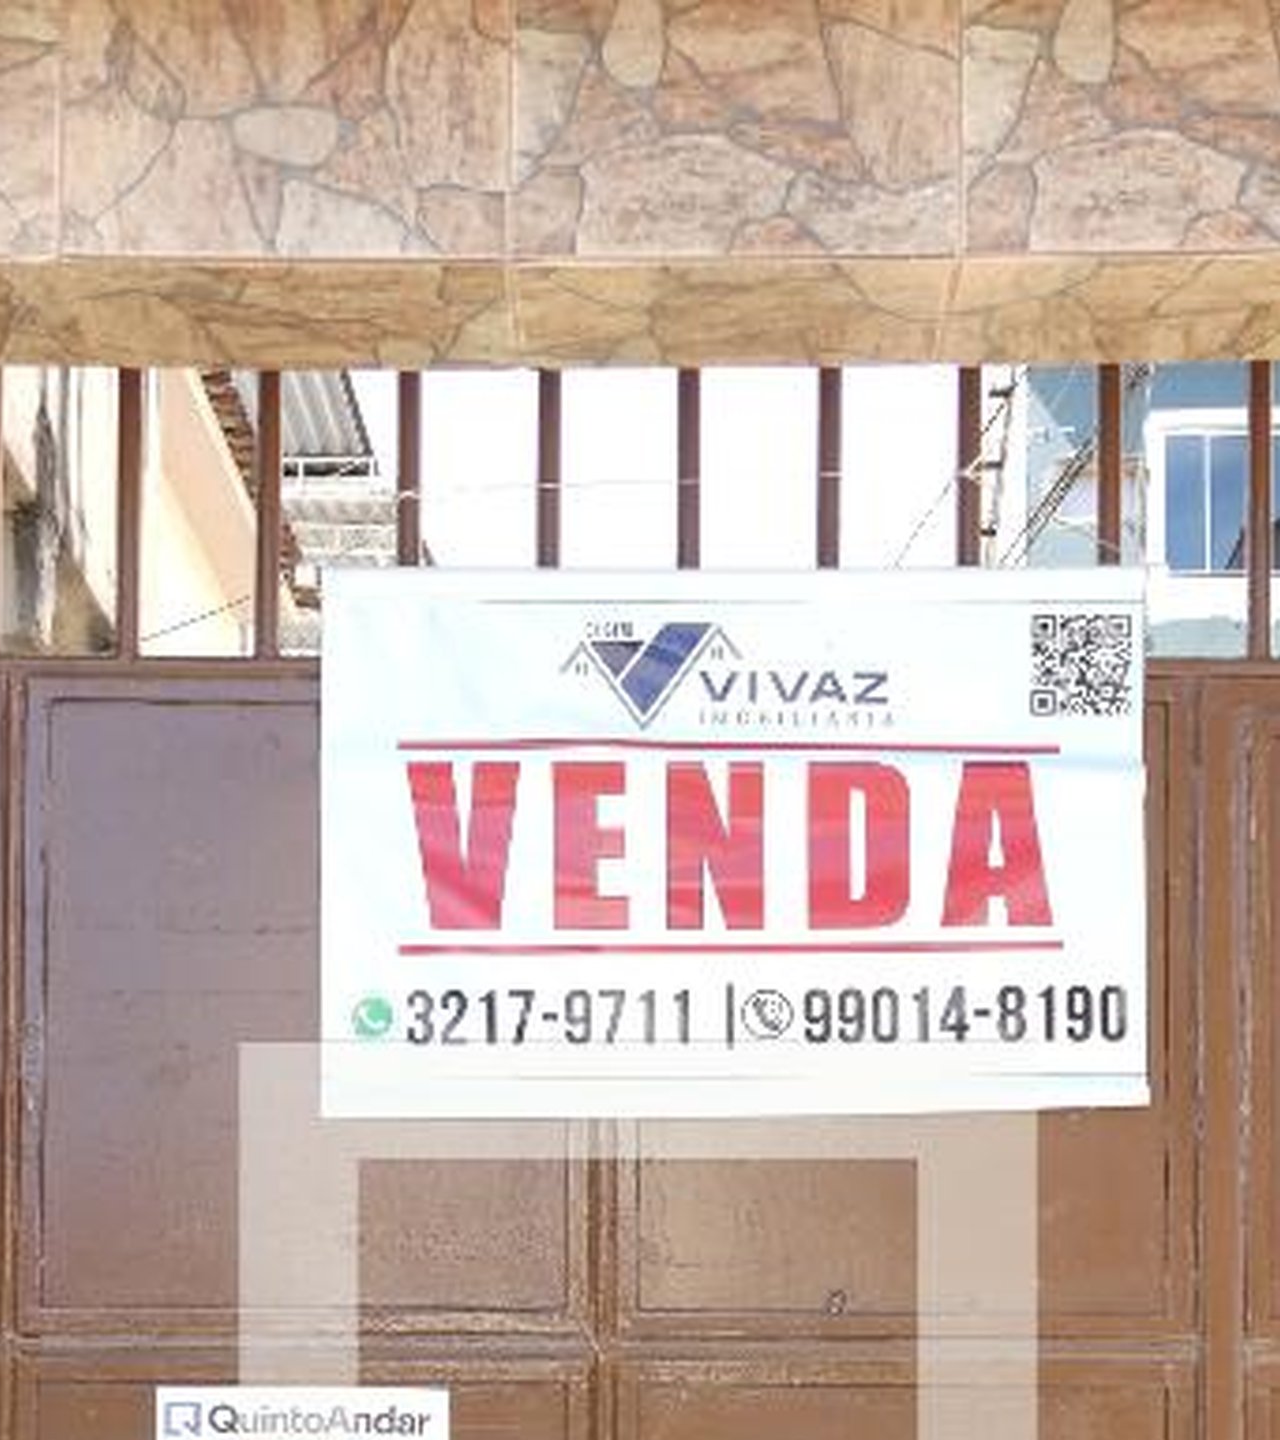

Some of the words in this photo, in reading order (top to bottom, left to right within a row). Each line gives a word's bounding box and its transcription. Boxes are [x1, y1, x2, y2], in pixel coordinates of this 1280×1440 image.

[700, 671, 888, 704] VIVAZ
[406, 761, 1054, 931] VENDA
[407, 990, 692, 1044] 3217-9711
[803, 985, 1127, 1043] 99014-8190
[208, 1404, 431, 1437] QuintoAndar
